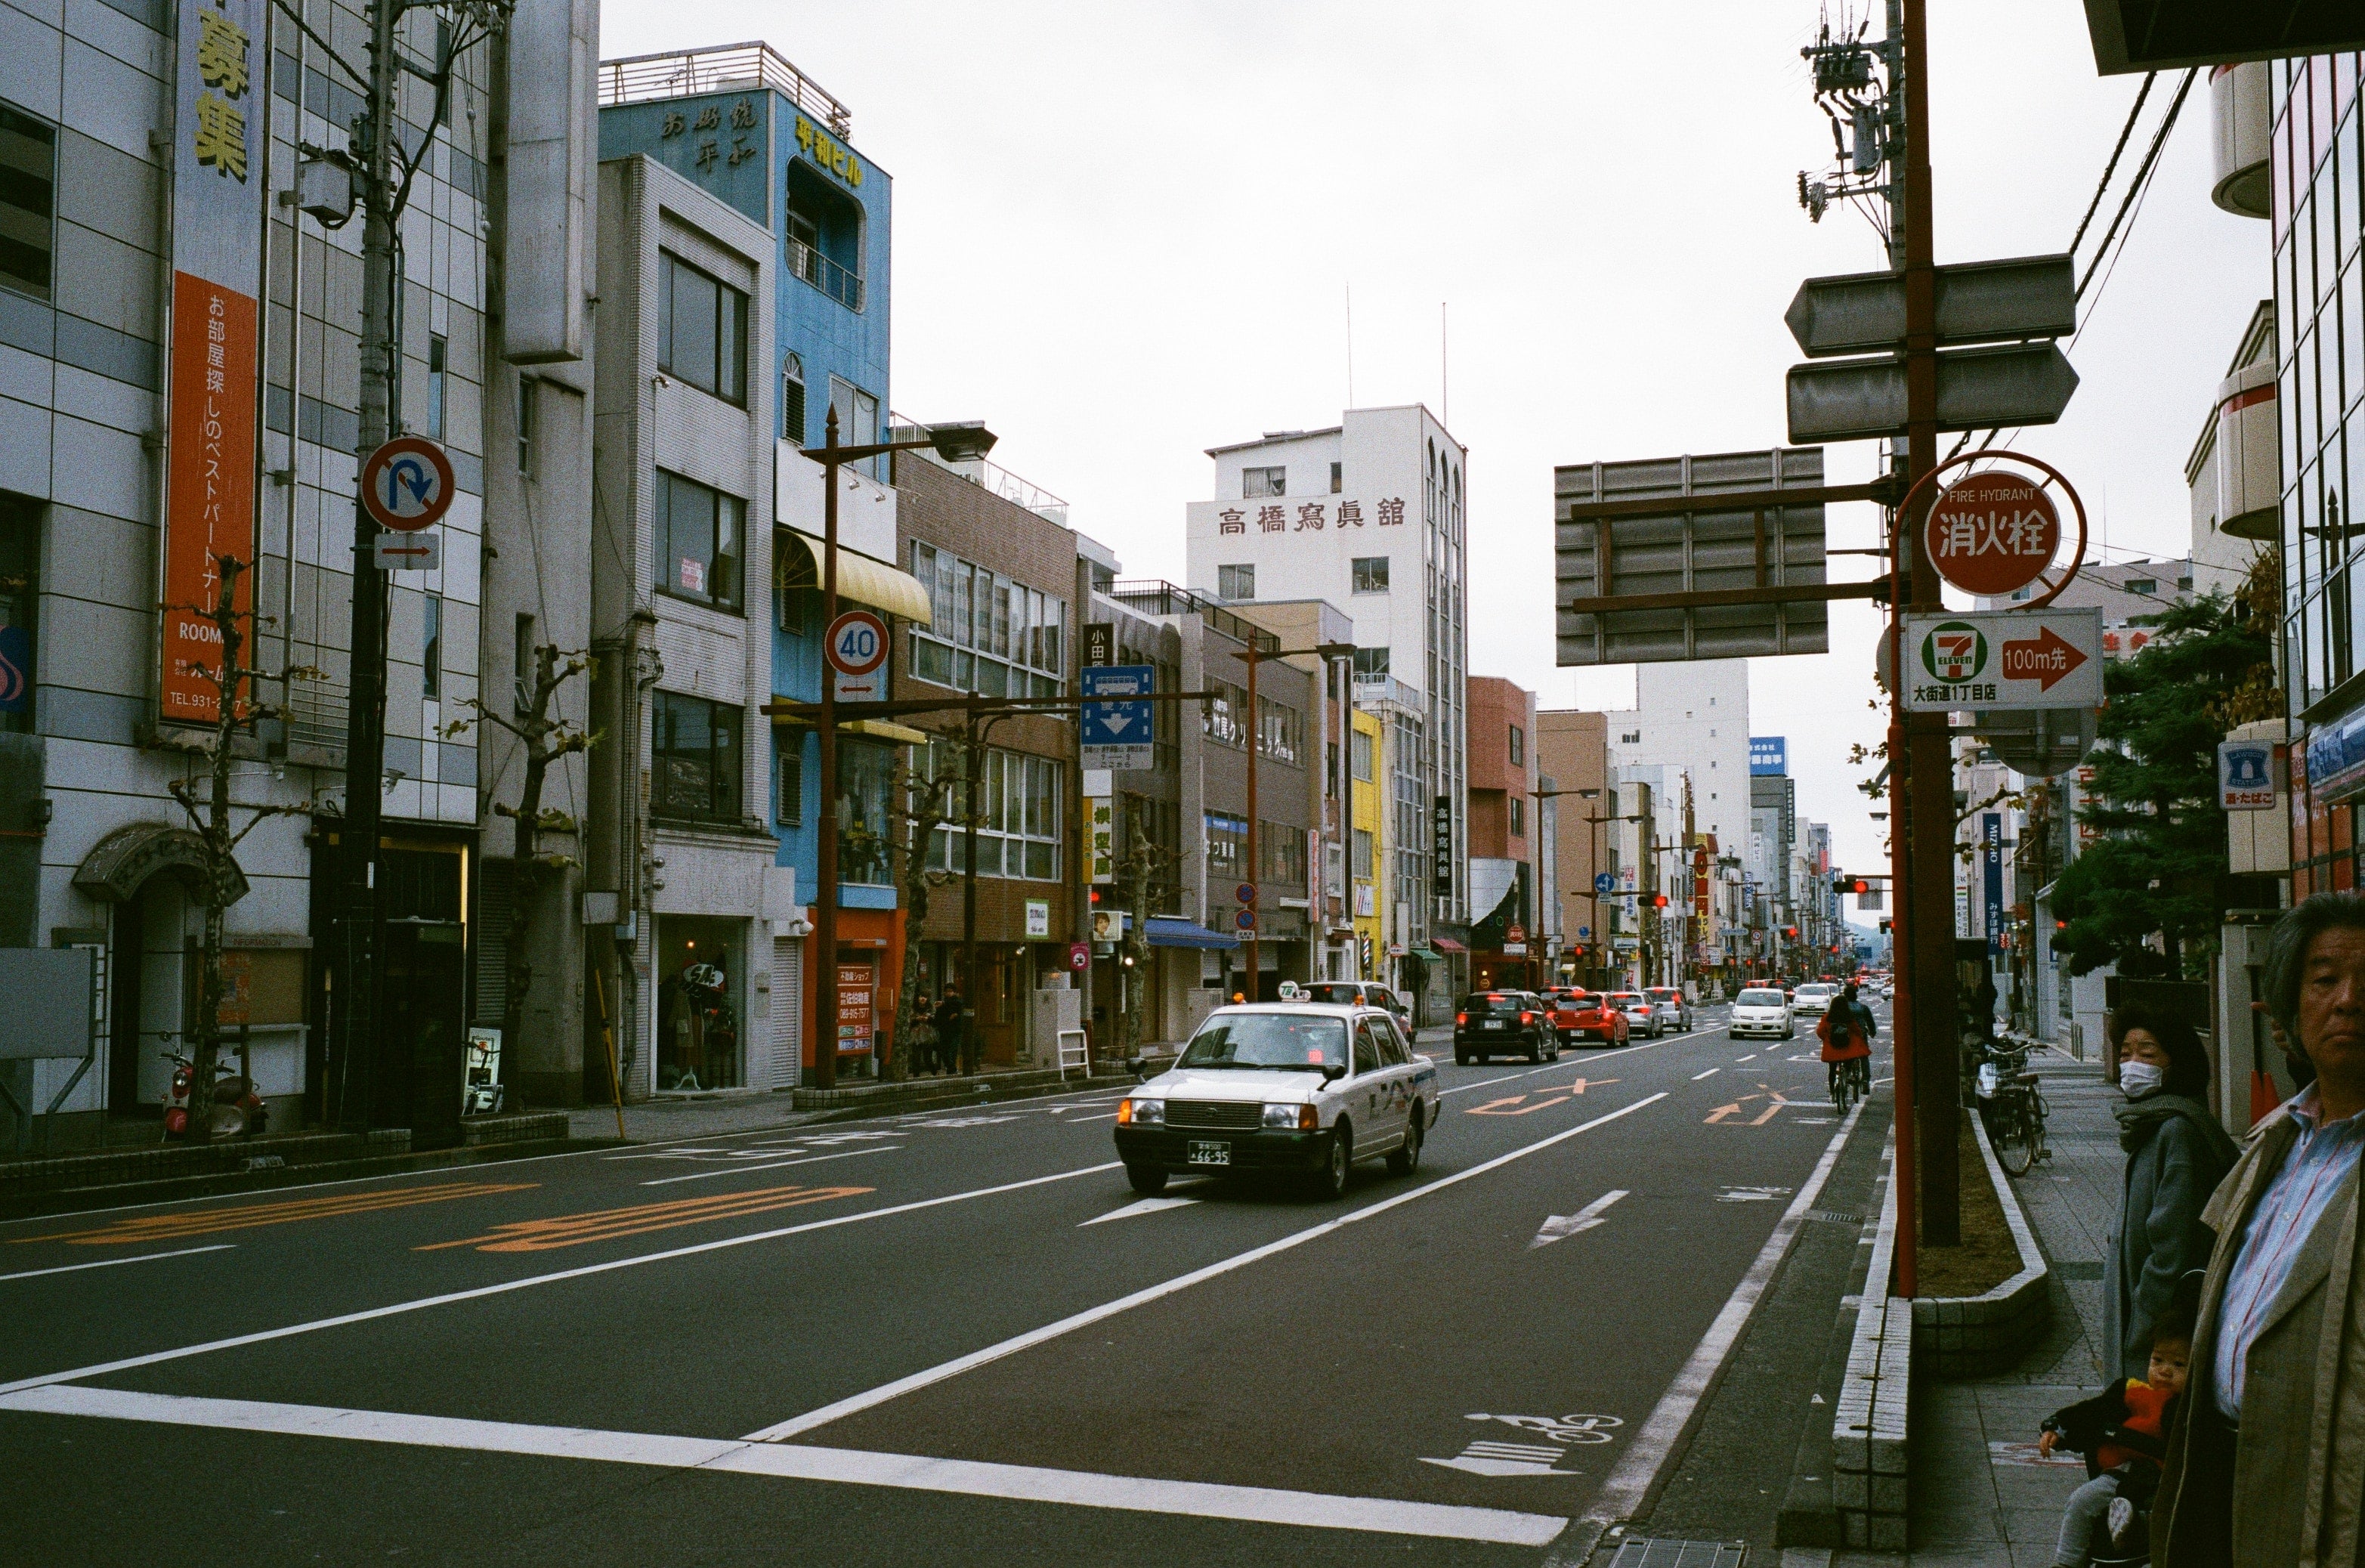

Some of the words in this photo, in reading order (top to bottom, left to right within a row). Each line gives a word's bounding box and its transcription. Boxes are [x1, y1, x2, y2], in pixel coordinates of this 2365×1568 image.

[195, 8, 251, 185] 募集
[795, 115, 864, 187] 平和ビル
[202, 294, 224, 613] お部屋探しのベストパートナー
[1949, 490, 1975, 503] FIRE
[1980, 487, 2036, 502] HYDRANT
[1939, 509, 2048, 558] 消火栓
[840, 629, 875, 657] 40
[2005, 648, 2066, 670] 100m先
[1914, 684, 1996, 703] 大街道1丁目店
[1989, 902, 1999, 945] みずほ銀行
[1198, 1151, 1229, 1162] 66-95
